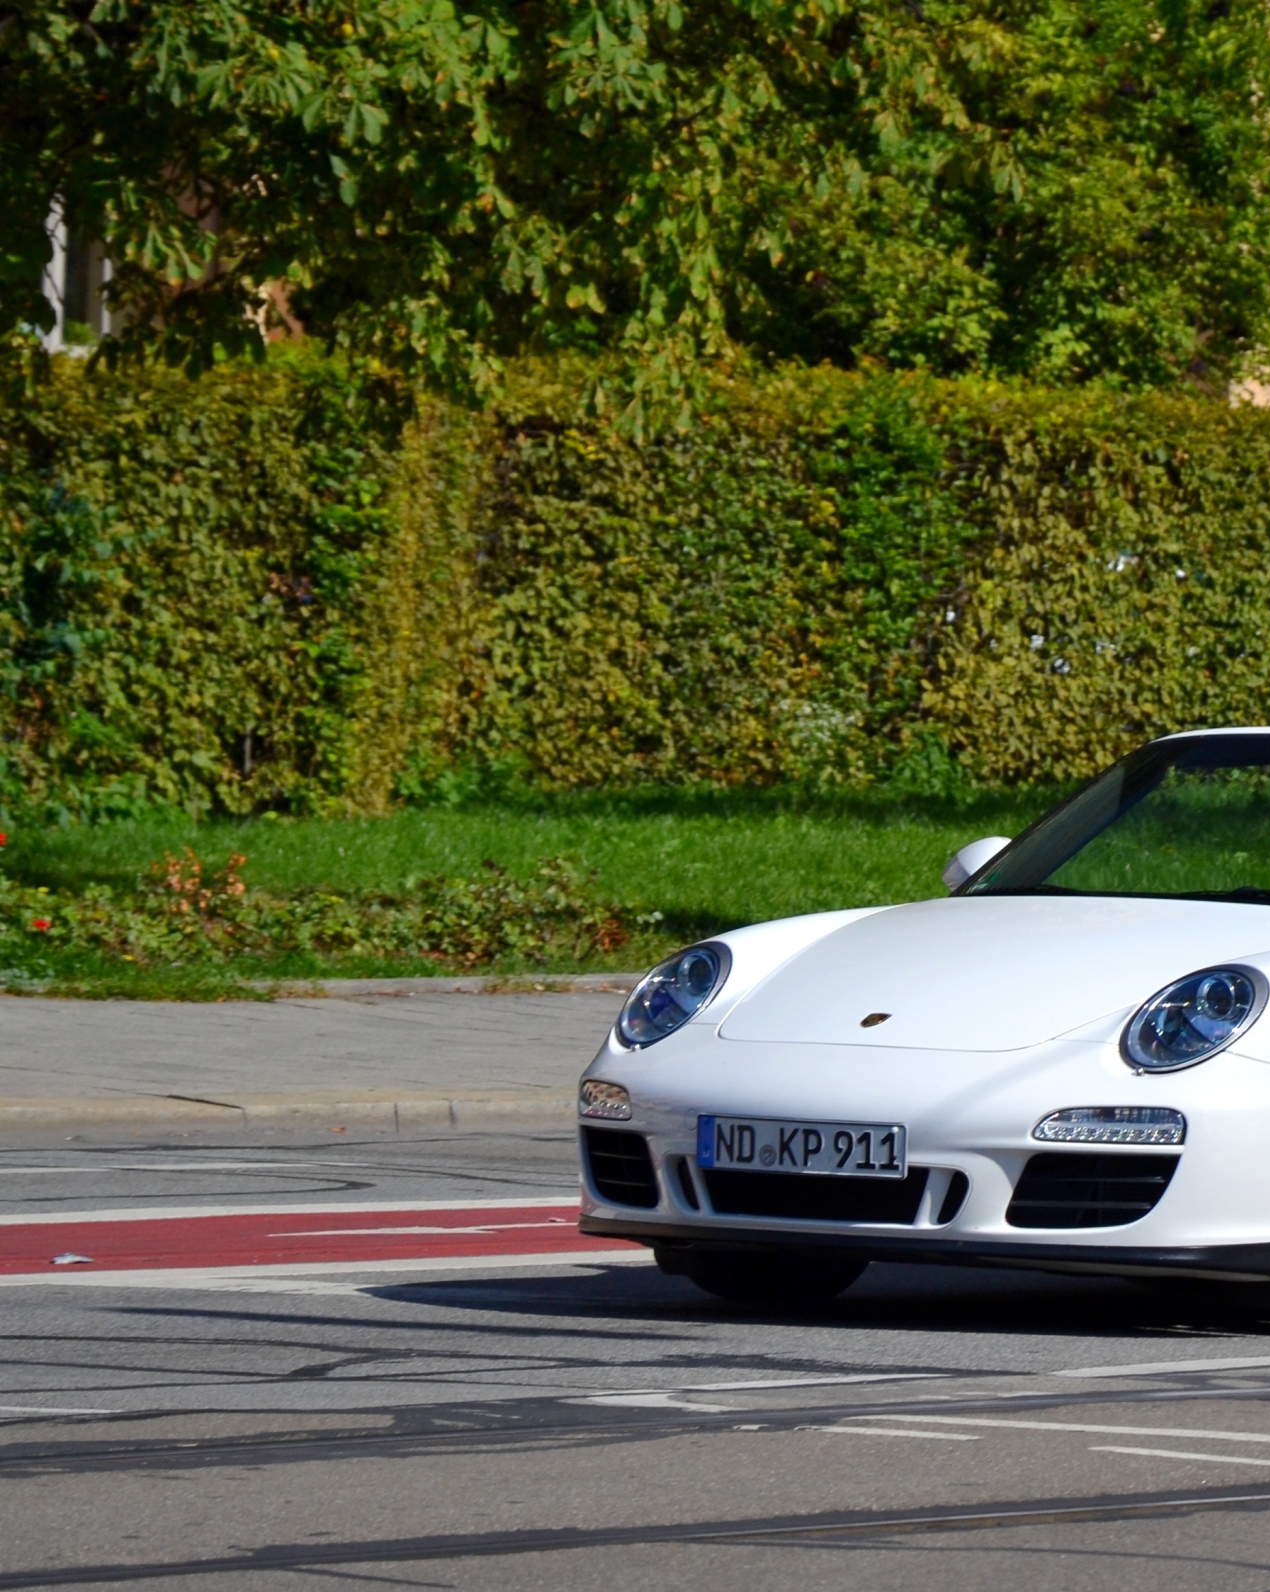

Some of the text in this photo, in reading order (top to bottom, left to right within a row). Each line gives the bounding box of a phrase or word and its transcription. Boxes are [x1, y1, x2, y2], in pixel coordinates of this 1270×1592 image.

[715, 1123, 901, 1172] ND KP 911
